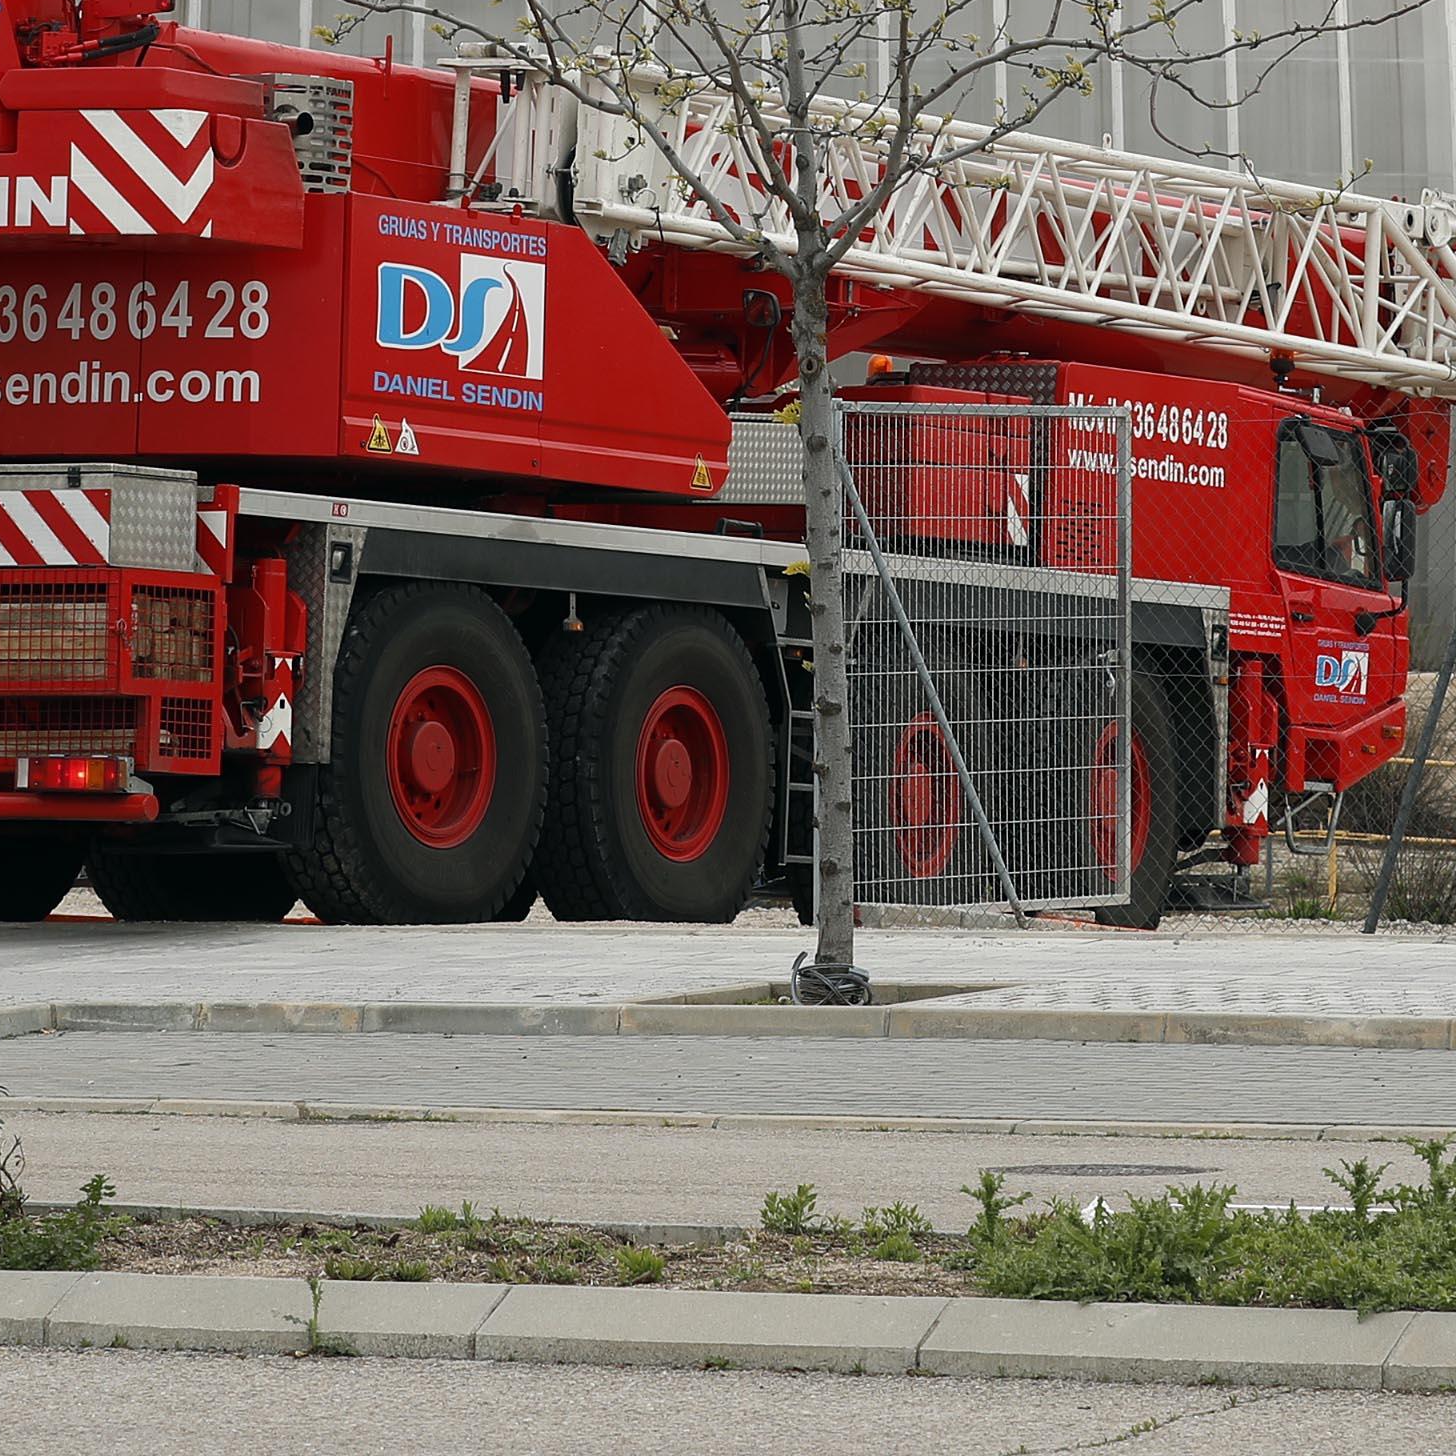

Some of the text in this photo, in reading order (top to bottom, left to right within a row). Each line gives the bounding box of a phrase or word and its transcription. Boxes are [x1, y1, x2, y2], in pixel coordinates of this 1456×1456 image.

[378, 214, 547, 257] GRUAS Y TRANSPORTES
[56, 282, 117, 340] 48
[127, 280, 193, 340] 64
[203, 280, 271, 340] 28
[373, 370, 543, 412] DANIEL SENDIN
[1157, 404, 1179, 443] 48
[1182, 408, 1204, 447] 64
[1206, 411, 1228, 449] 28
[1067, 448, 1225, 488] www.sendin.com
